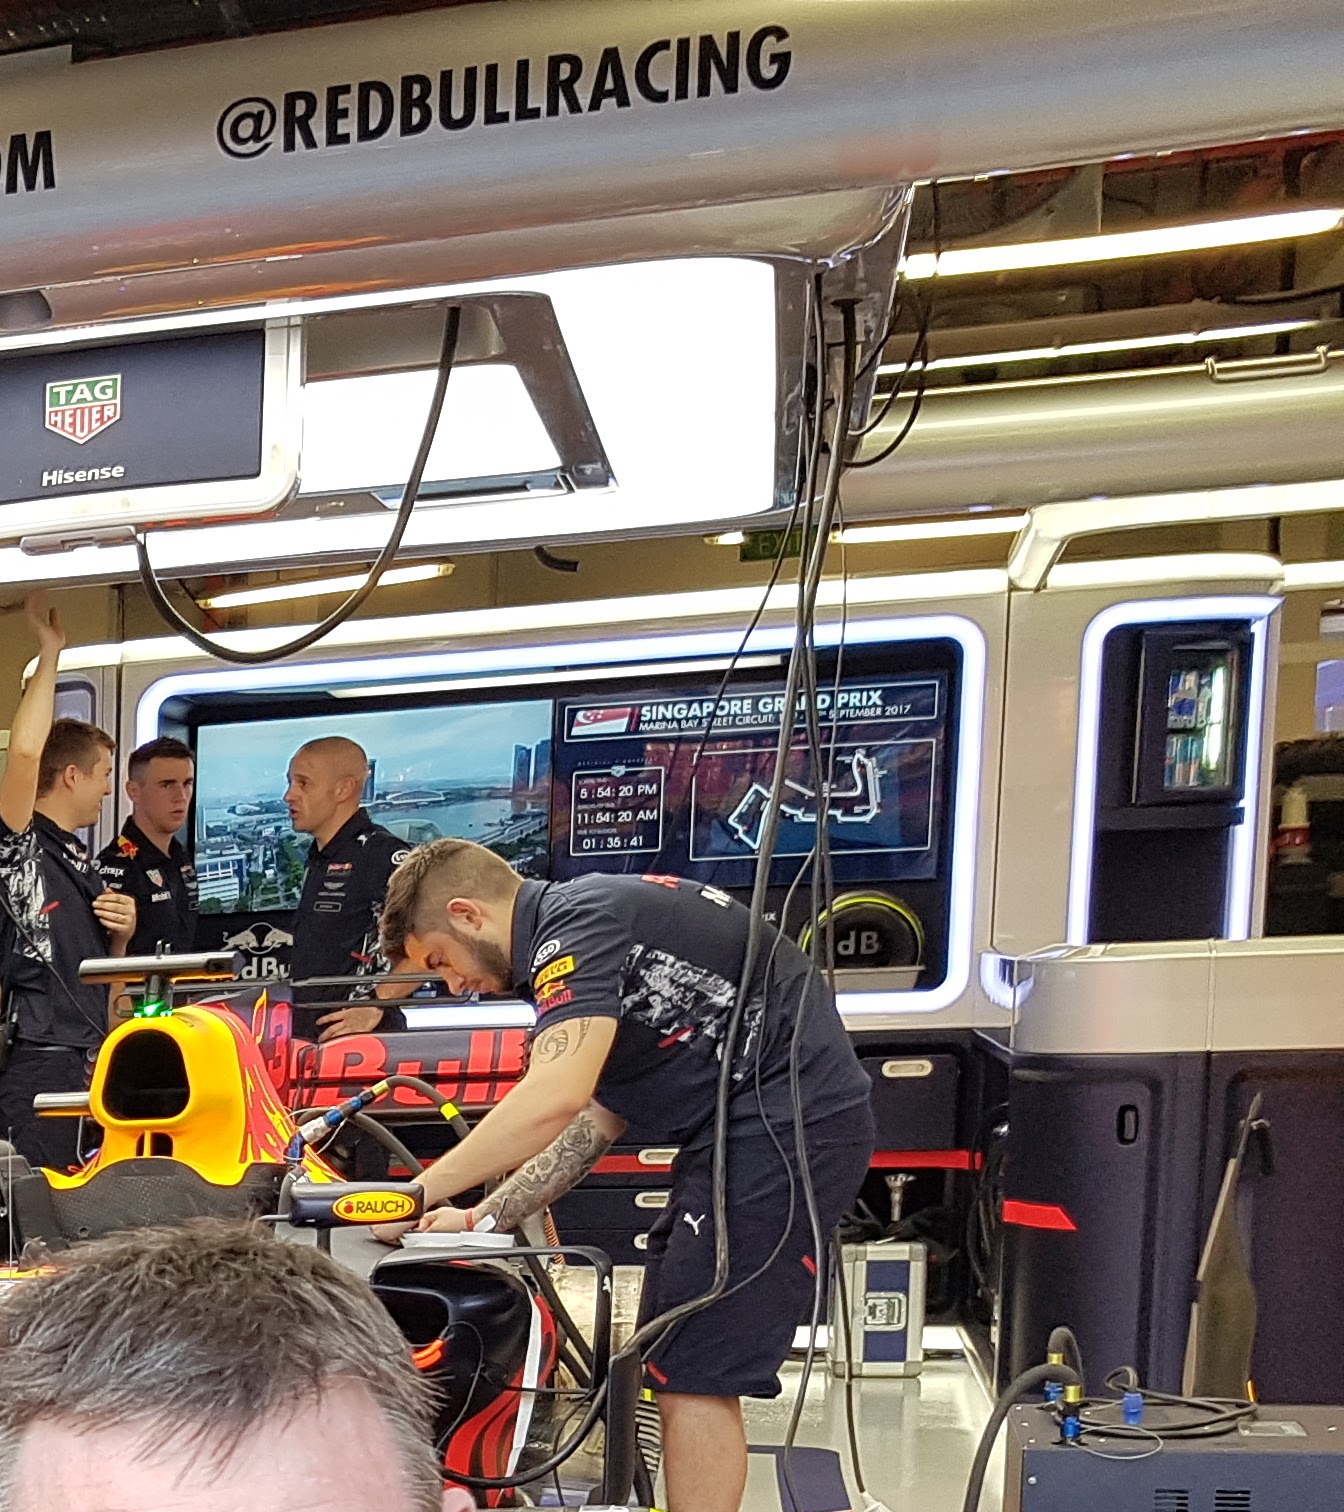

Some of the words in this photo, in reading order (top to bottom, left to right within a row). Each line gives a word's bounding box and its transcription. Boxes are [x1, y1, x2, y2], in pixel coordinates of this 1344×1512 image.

[215, 24, 792, 160] @REDBULLRACING
[53, 379, 114, 404] TAG
[50, 406, 116, 440] HEUER
[42, 465, 125, 487] Hisense
[640, 698, 752, 721] SINGAPORE
[837, 689, 883, 709] PRIX
[639, 720, 678, 732] MARINA
[680, 719, 699, 729] BAY
[884, 704, 911, 717] 2017
[637, 783, 658, 796] PM
[636, 808, 658, 822] AM
[355, 1199, 405, 1215] RAUCH
